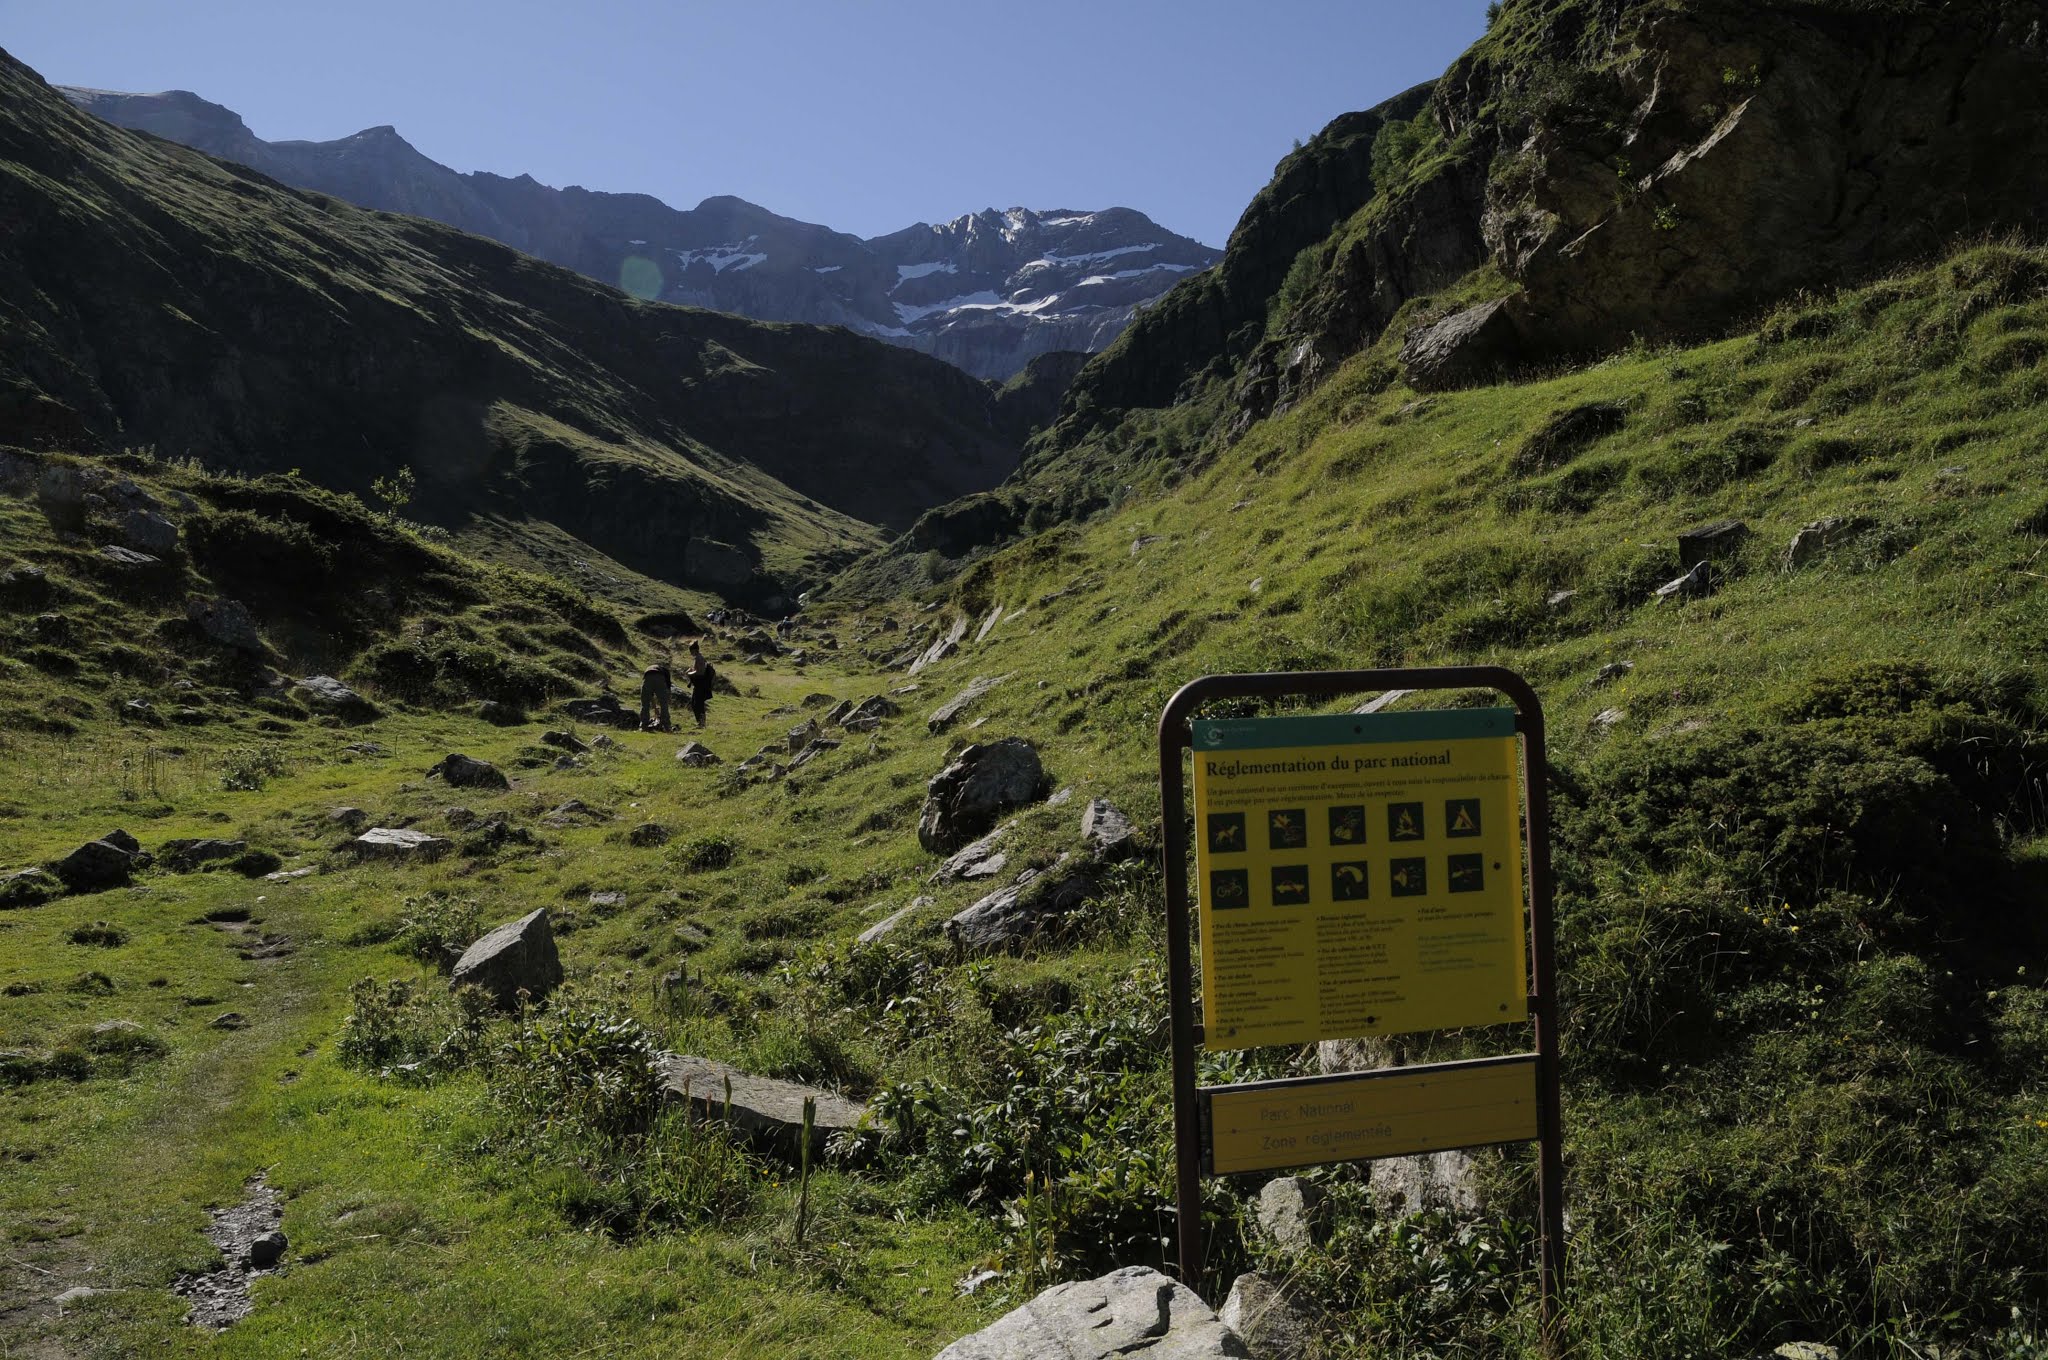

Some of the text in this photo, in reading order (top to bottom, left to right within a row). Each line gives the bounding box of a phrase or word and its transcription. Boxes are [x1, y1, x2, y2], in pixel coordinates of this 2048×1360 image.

[1206, 750, 1451, 779] Réglementation du parc national
[1260, 1100, 1354, 1121] Parc National
[1262, 1120, 1393, 1151] Zone réglementée
